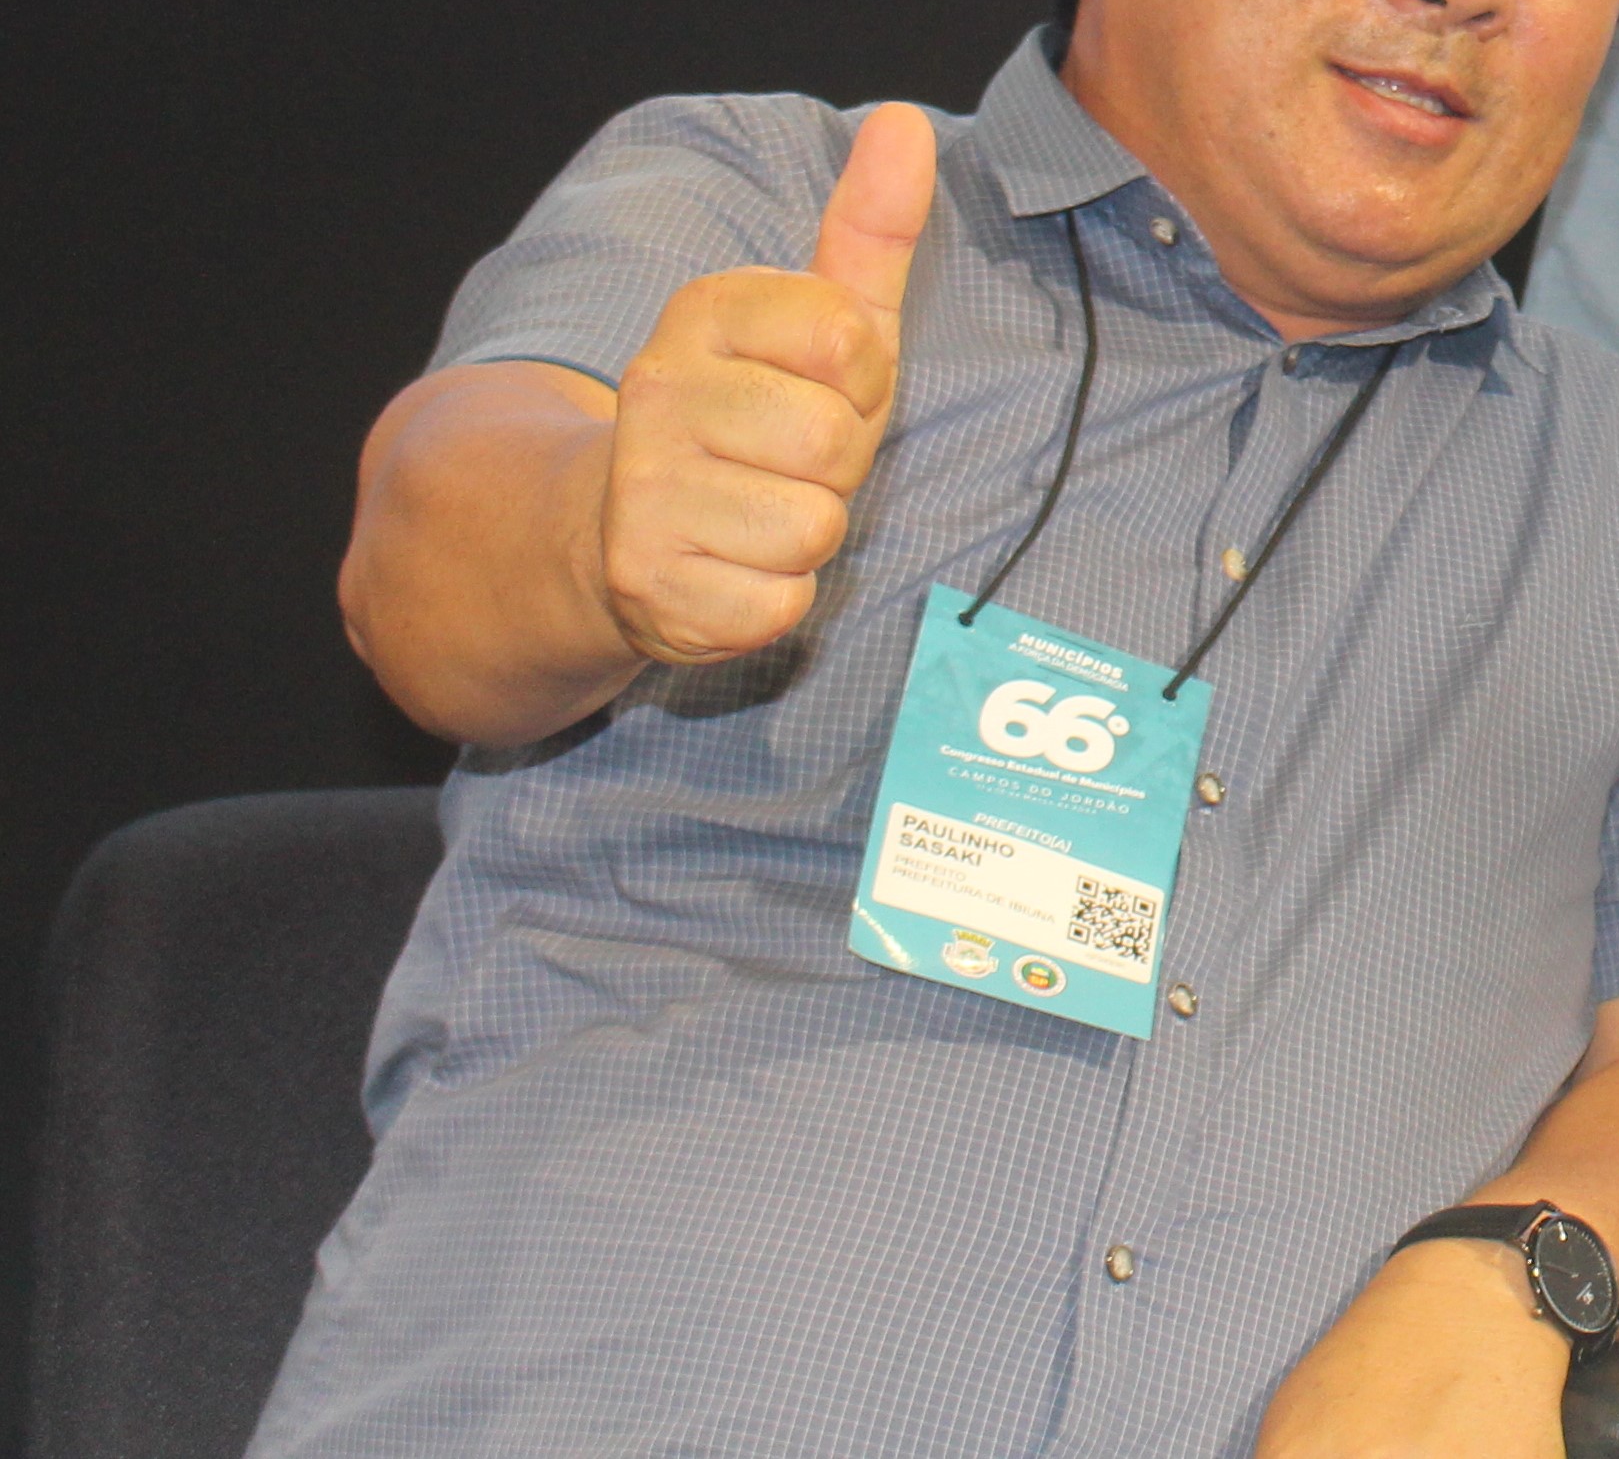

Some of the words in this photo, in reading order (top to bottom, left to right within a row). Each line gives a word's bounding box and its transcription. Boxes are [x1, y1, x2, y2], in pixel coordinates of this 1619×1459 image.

[1018, 632, 1124, 680] MUNICÍPIOS
[979, 679, 1130, 774] 66º
[940, 744, 1006, 769] Congresso
[1006, 759, 1061, 782] Estadual
[1061, 771, 1077, 786] de
[1079, 775, 1147, 800] Municípios
[948, 766, 1021, 791] CAMPOS
[1028, 784, 1053, 798] DO
[1061, 792, 1130, 815] JORDÃO
[899, 832, 983, 867] SASAKI
[902, 814, 1015, 859] PAULINHO
[973, 811, 1073, 854] PREFEITO(A)
[892, 866, 984, 899] PREFEITURA
[986, 890, 1006, 907] DE
[894, 854, 967, 882] PREFEITO
